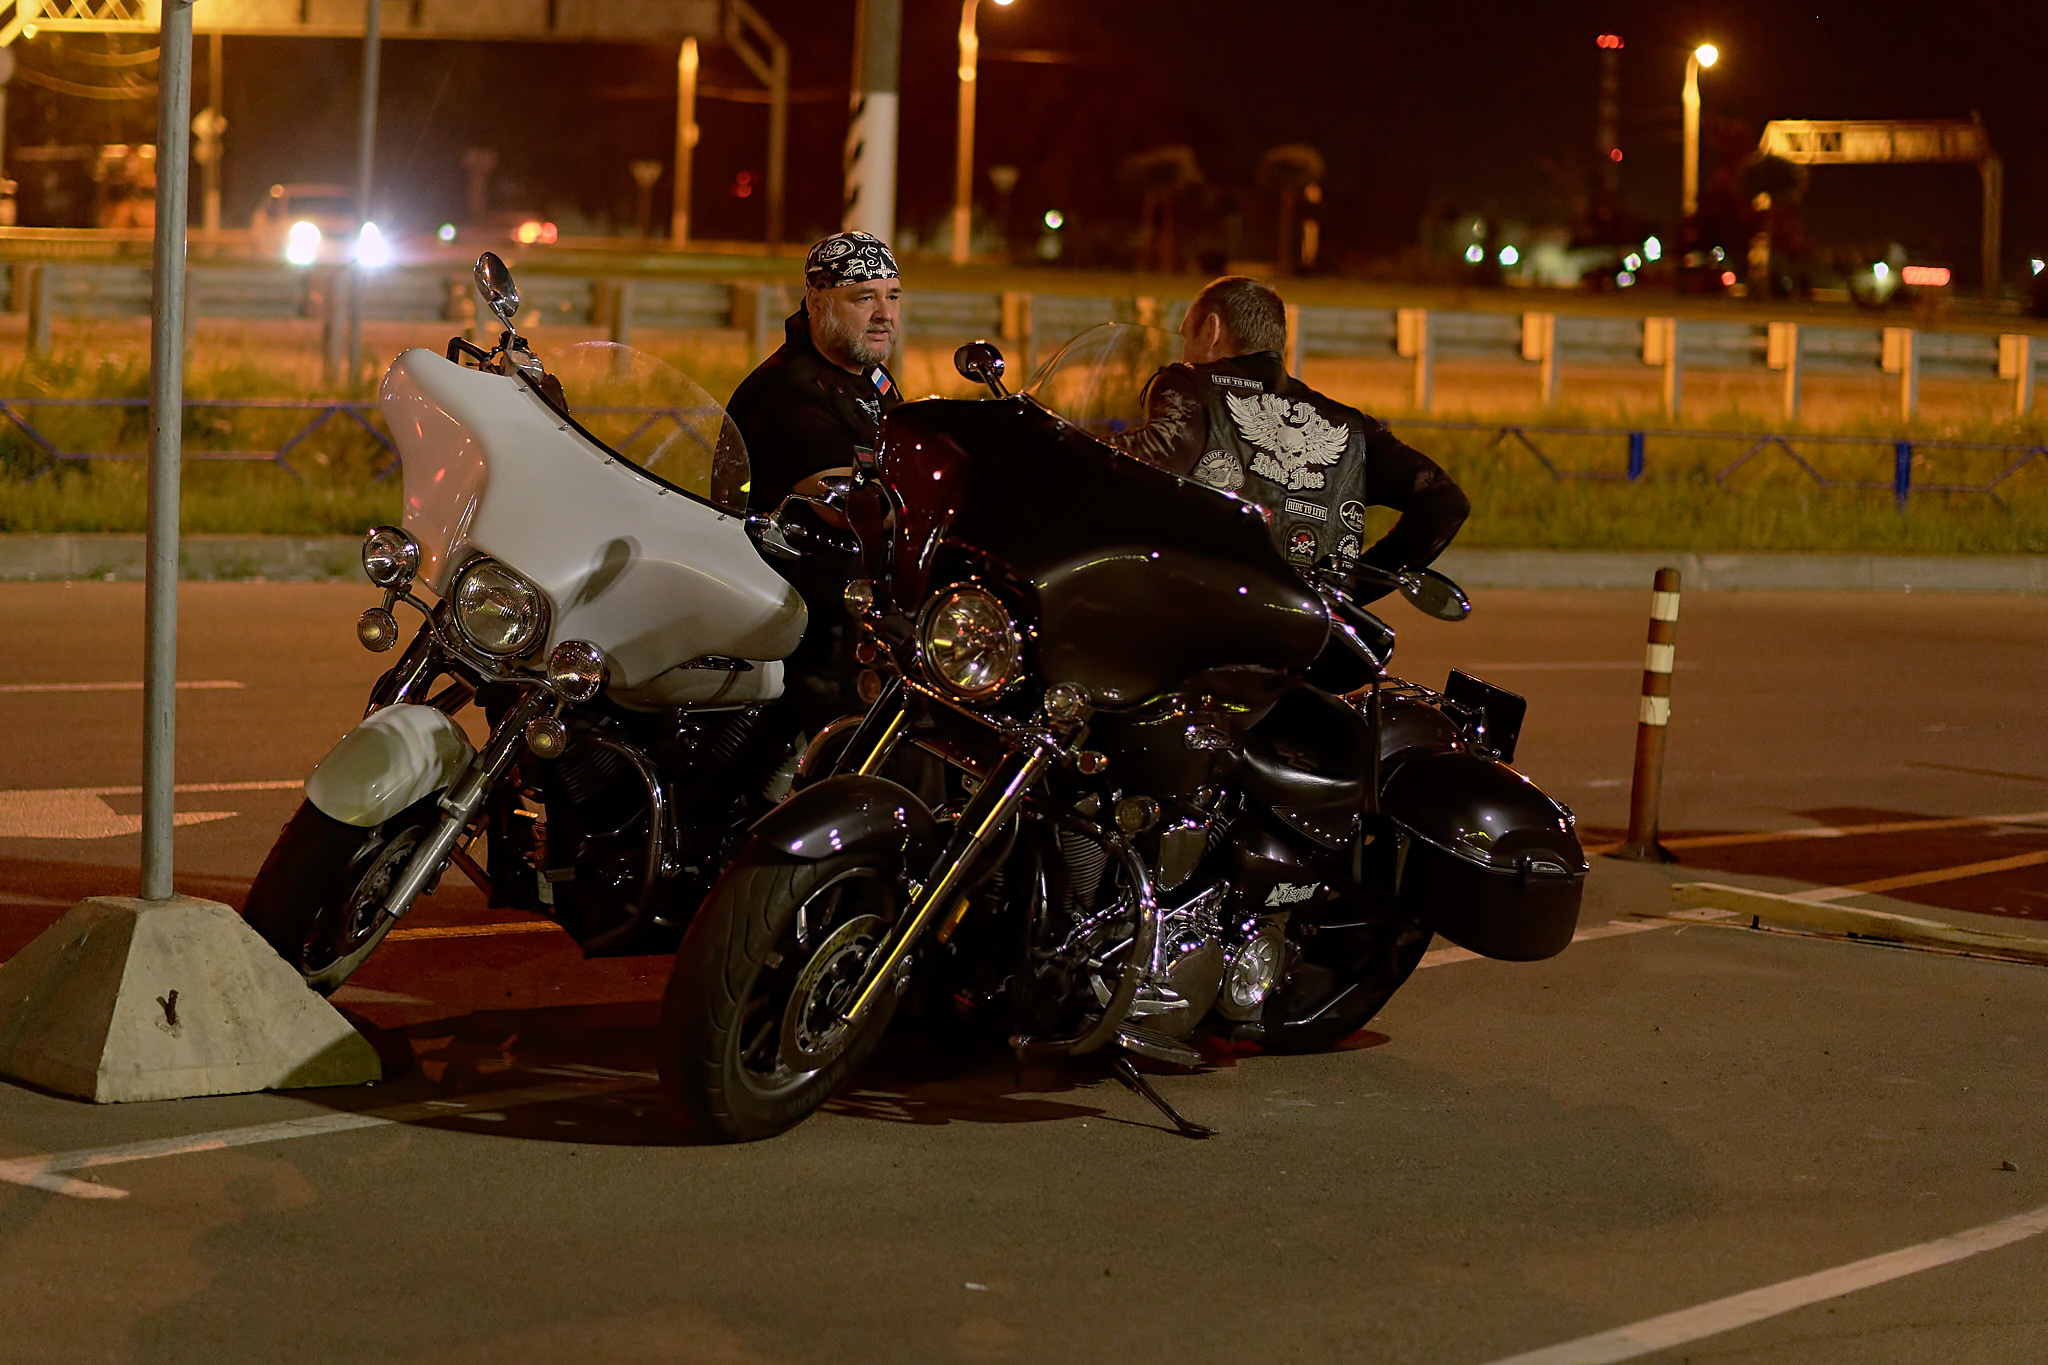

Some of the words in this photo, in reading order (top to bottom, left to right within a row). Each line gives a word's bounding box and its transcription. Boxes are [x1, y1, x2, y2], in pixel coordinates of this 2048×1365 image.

[1215, 376, 1232, 385] LIVE
[1244, 380, 1262, 389] RIDE
[1202, 451, 1224, 465] RIDE
[1224, 452, 1240, 472] FAST
[1250, 452, 1290, 485] Ride
[1288, 467, 1325, 490] Free
[1288, 501, 1304, 512] RIDE
[1304, 505, 1312, 514] TO
[1312, 507, 1326, 518] LIVE
